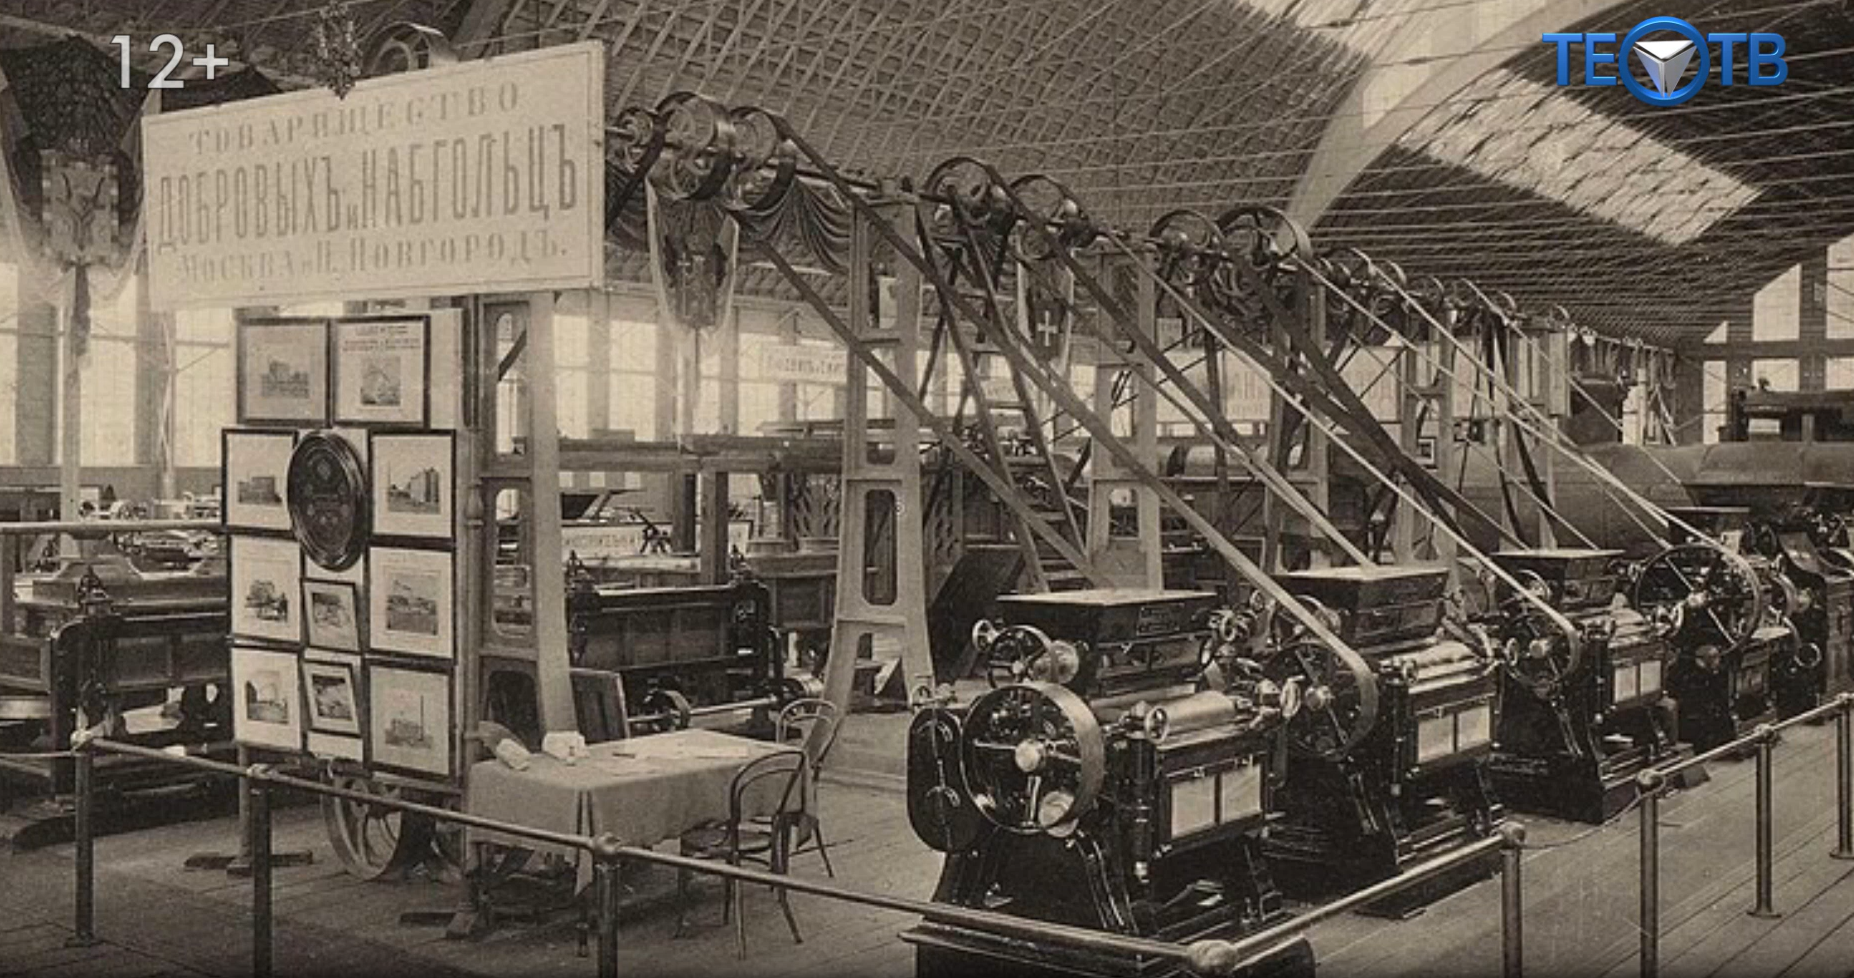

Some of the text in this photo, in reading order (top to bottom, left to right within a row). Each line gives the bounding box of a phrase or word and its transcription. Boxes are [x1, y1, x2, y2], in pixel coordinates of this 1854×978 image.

[188, 82, 518, 153] ТОВАРИЩЕСТВО
[158, 156, 340, 255] ДОБРОВЫХЪ
[361, 124, 577, 232] НАБГОЛЬЦЪ
